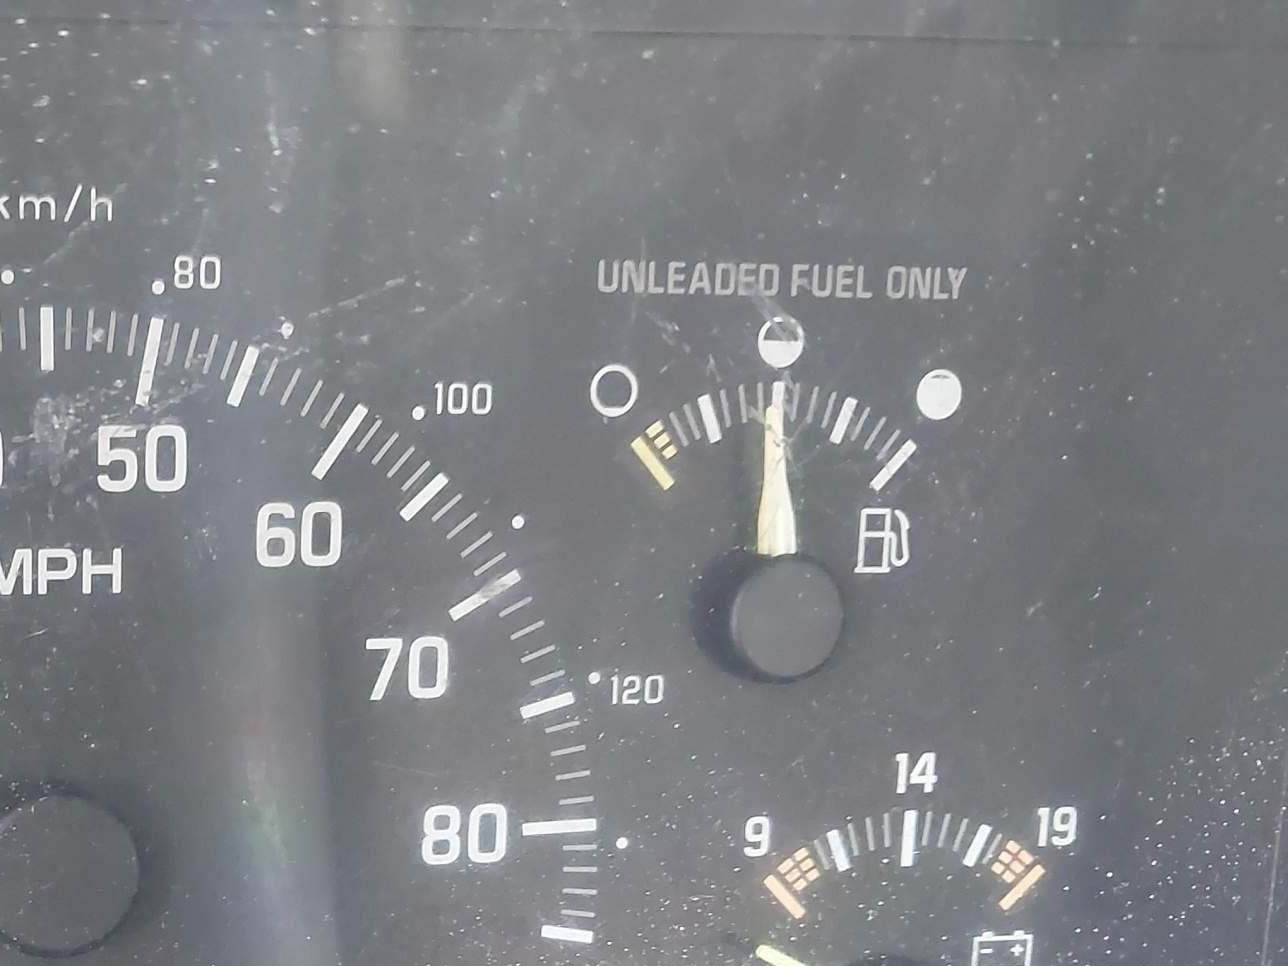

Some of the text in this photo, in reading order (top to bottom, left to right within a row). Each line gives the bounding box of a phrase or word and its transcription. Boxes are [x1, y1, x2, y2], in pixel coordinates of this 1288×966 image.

[174, 256, 222, 290] 80
[597, 260, 967, 301] UNLEADED FUEL ONLY
[433, 382, 493, 416] 100
[96, 425, 188, 492] 50
[255, 501, 342, 567] 60
[364, 636, 450, 701] 70
[610, 674, 665, 706] 120
[895, 752, 938, 794] 14
[420, 804, 508, 865] 80
[744, 816, 771, 857] 9
[1037, 807, 1078, 846] 19
